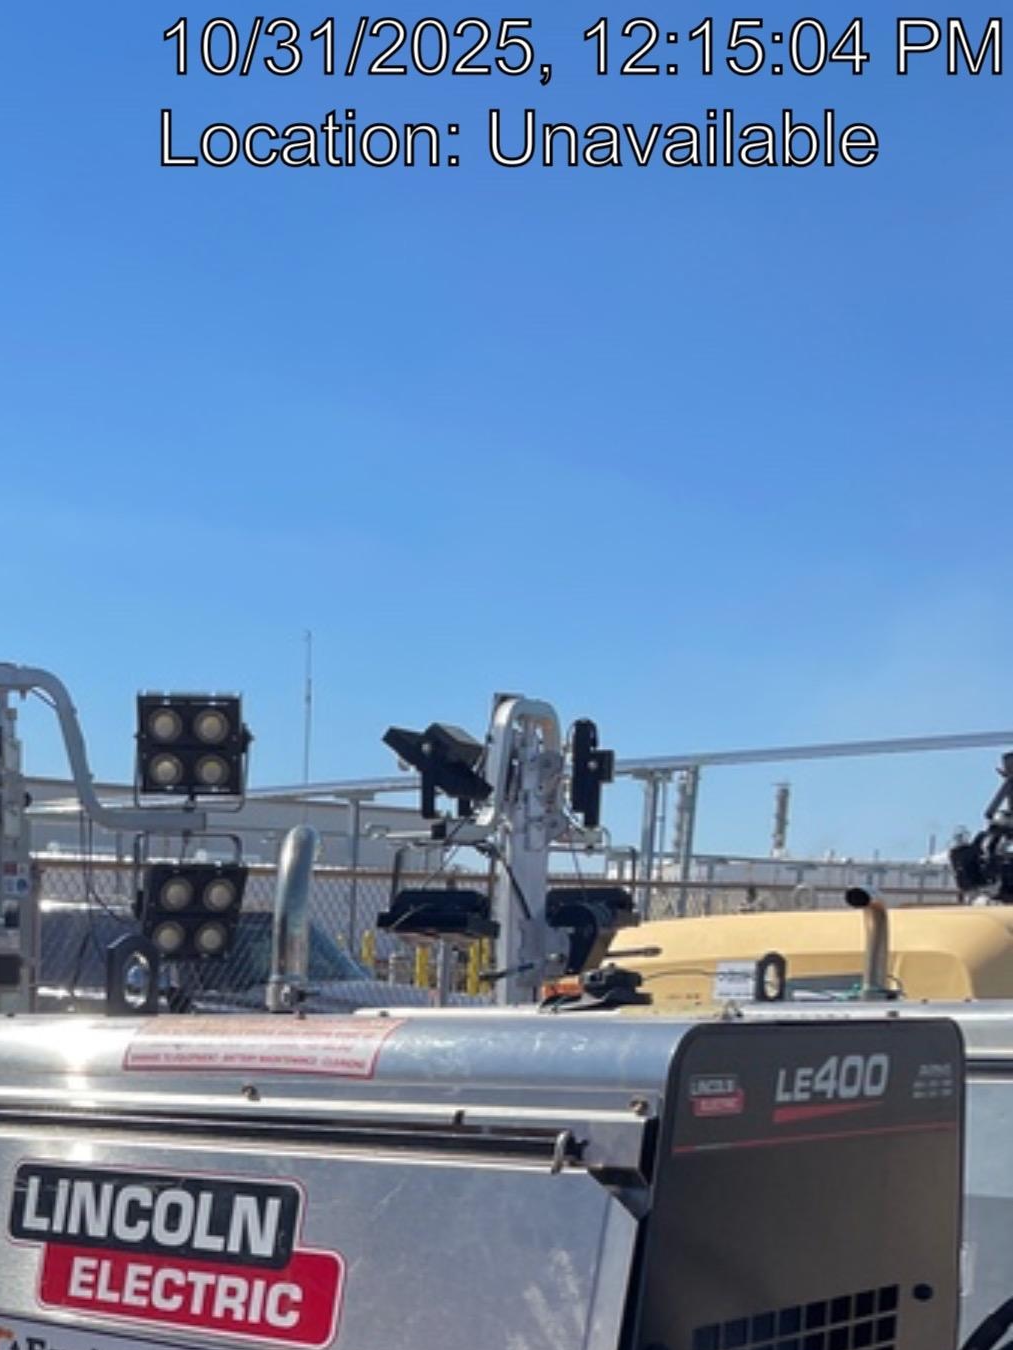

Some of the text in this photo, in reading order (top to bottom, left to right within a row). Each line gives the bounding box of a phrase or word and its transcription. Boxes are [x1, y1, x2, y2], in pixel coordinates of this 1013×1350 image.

[775, 1053, 889, 1102] LE400
[22, 1176, 281, 1258] LINCOLN
[68, 1256, 303, 1328] ELECTRIC
